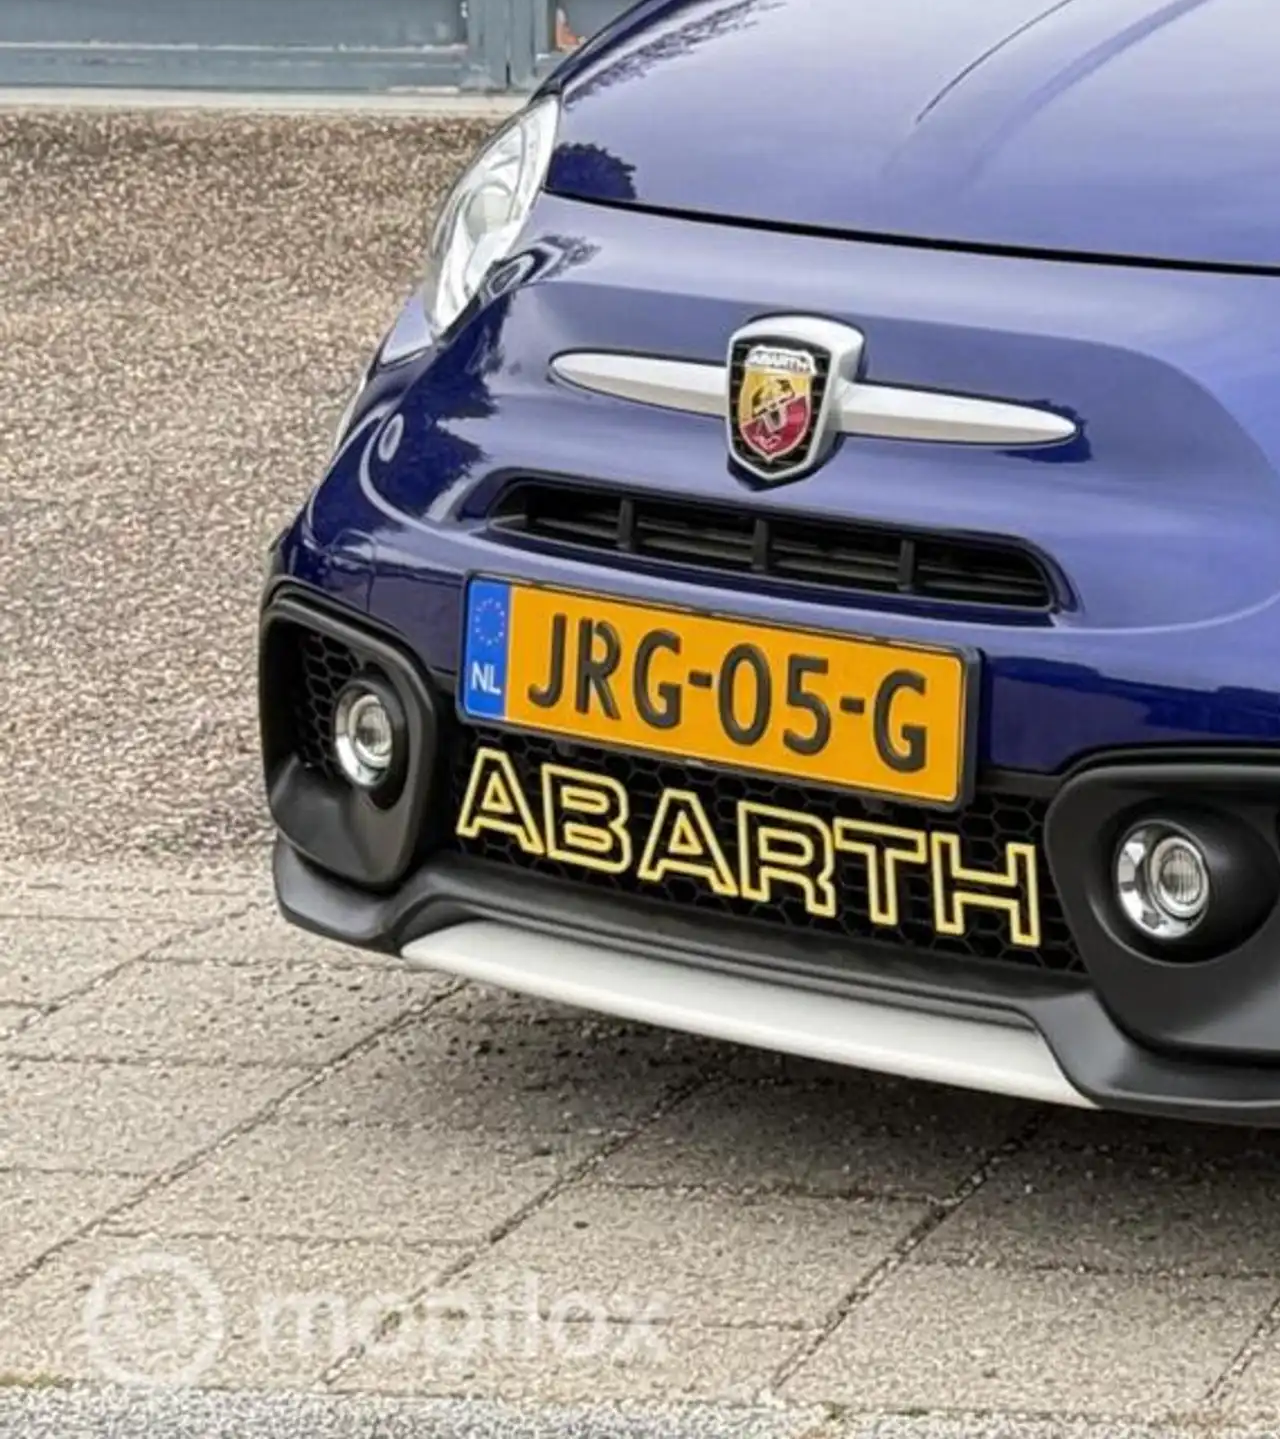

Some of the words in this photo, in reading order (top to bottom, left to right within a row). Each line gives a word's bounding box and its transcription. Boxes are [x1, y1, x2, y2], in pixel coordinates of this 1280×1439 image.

[470, 663, 502, 696] NL
[527, 612, 927, 774] JRG-05-G
[456, 747, 1039, 947] ABARTH
